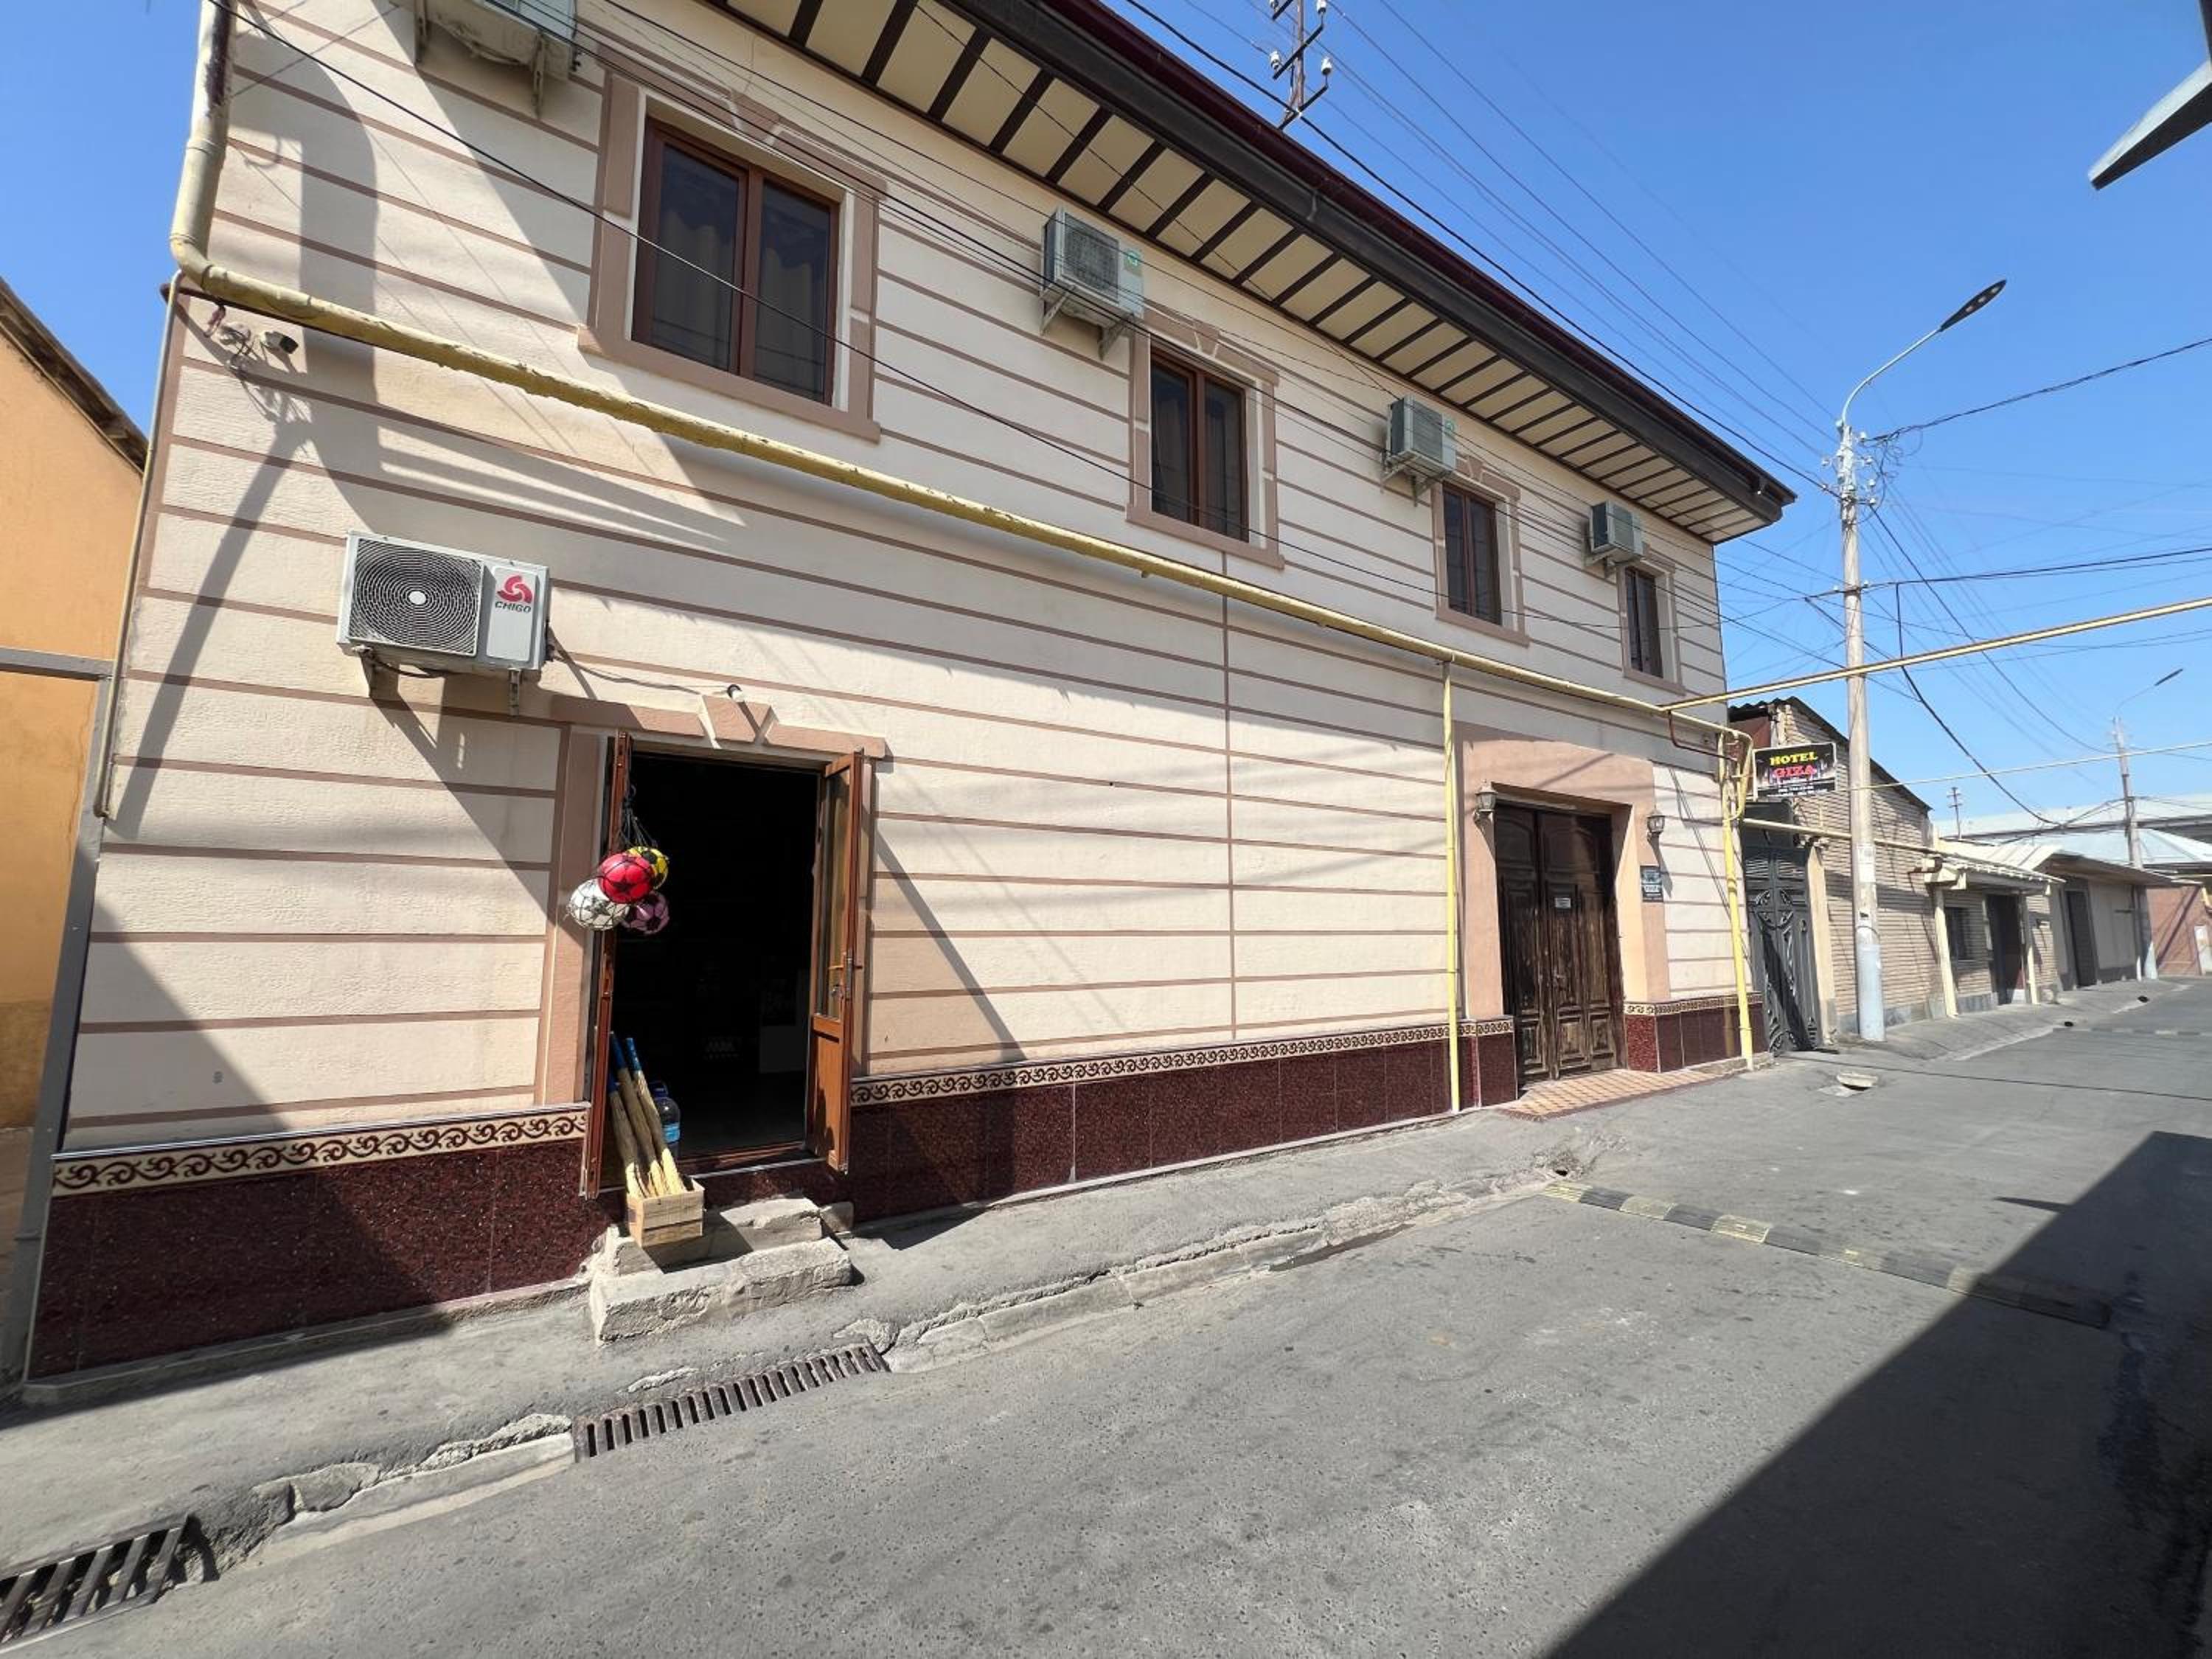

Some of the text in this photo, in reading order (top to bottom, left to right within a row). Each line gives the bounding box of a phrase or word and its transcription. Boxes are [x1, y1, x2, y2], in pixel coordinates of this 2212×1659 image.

[495, 601, 532, 613] CHIGO
[1769, 751, 1818, 766] HOTEL
[1773, 765, 1816, 778] GIZA
